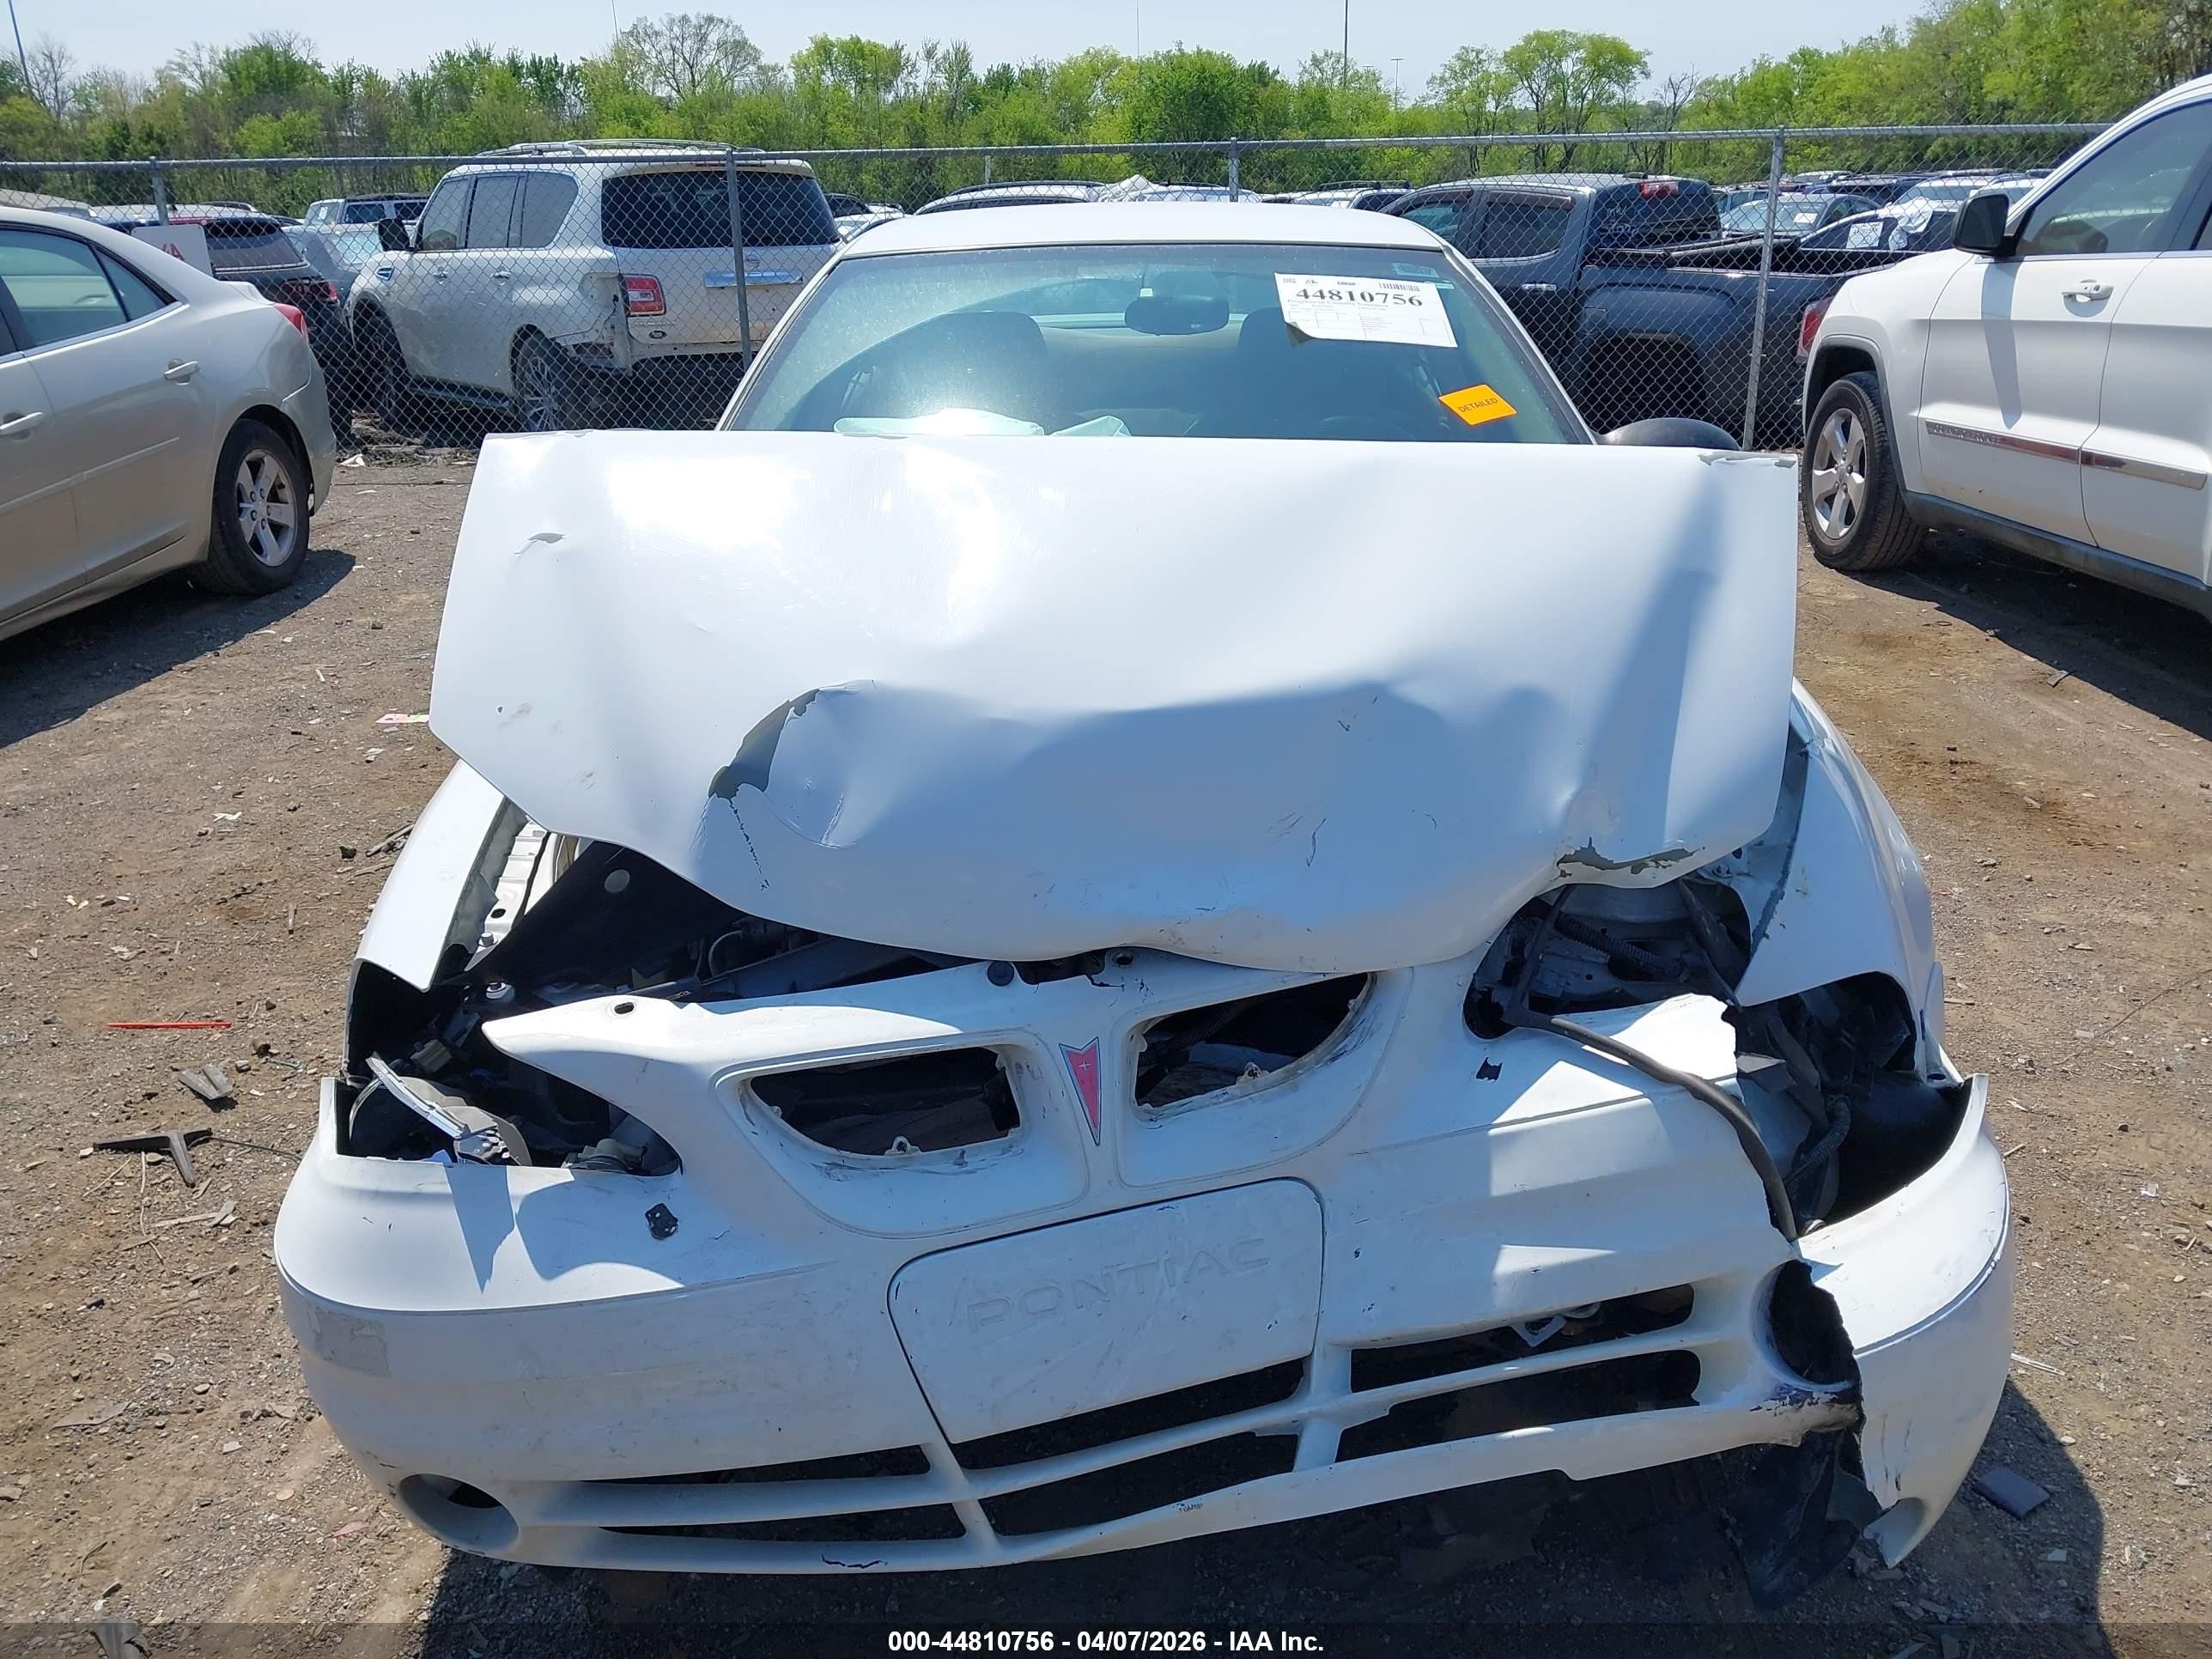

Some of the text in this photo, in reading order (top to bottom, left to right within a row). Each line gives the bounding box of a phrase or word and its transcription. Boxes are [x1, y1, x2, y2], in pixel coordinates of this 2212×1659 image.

[1296, 289, 1423, 307] 44810756
[1457, 398, 1498, 412] DETAILED
[966, 1237, 1269, 1334] PONTIAC
